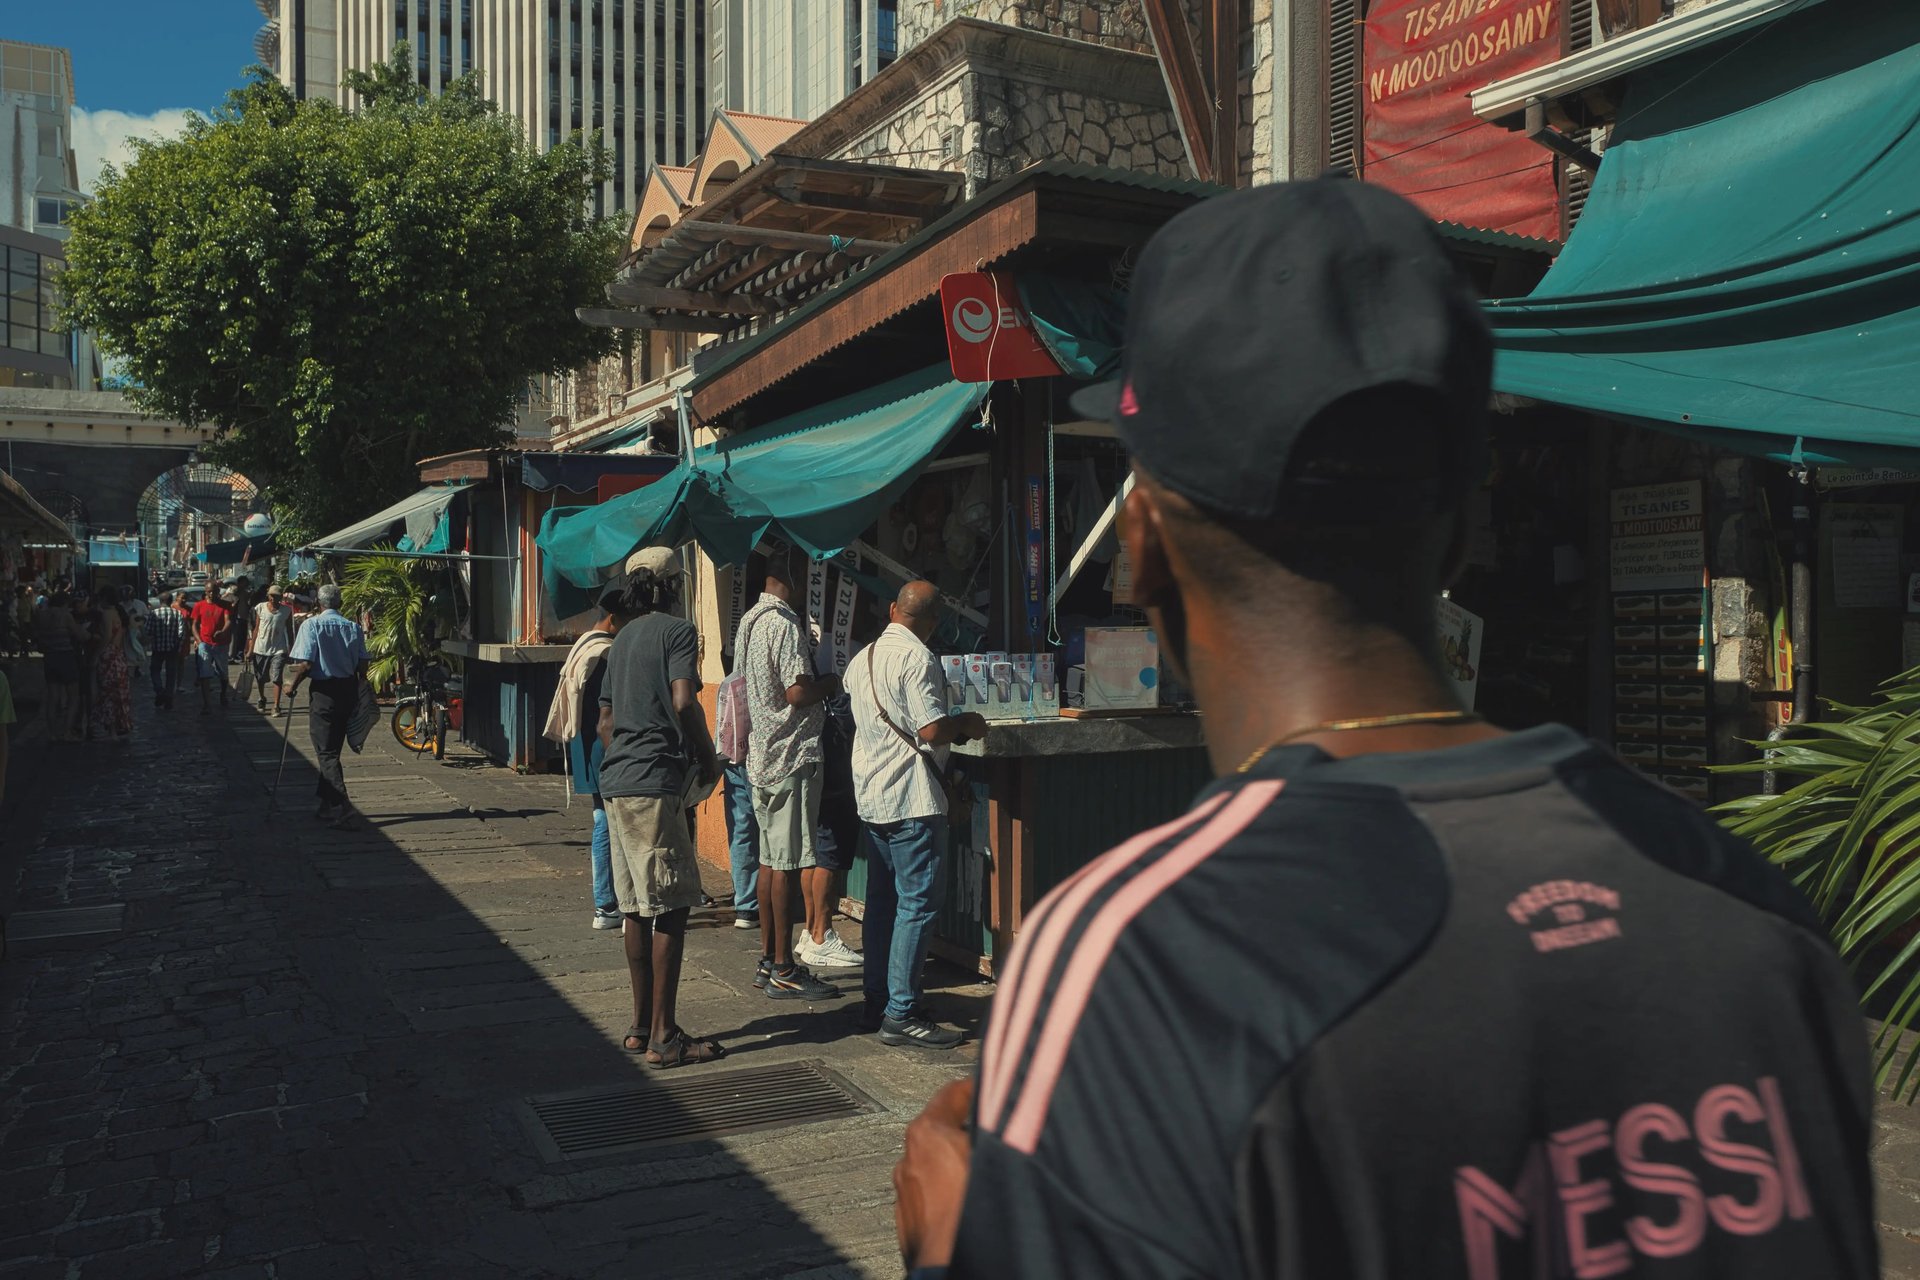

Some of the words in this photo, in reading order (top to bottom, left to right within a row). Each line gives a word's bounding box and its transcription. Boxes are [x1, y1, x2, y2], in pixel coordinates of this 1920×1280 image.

[1404, 0, 1501, 43] TISANE
[1622, 499, 1690, 516] TISANES
[811, 571, 822, 586] 14
[733, 580, 742, 595] 20
[810, 590, 821, 606] 22
[839, 590, 852, 607] 27
[730, 596, 742, 647] millions
[809, 610, 820, 626] 31
[837, 609, 849, 627] 29
[809, 630, 819, 647] 40
[835, 630, 846, 646] 35
[835, 650, 847, 667] 40
[1453, 1075, 1813, 1280] MESSI
